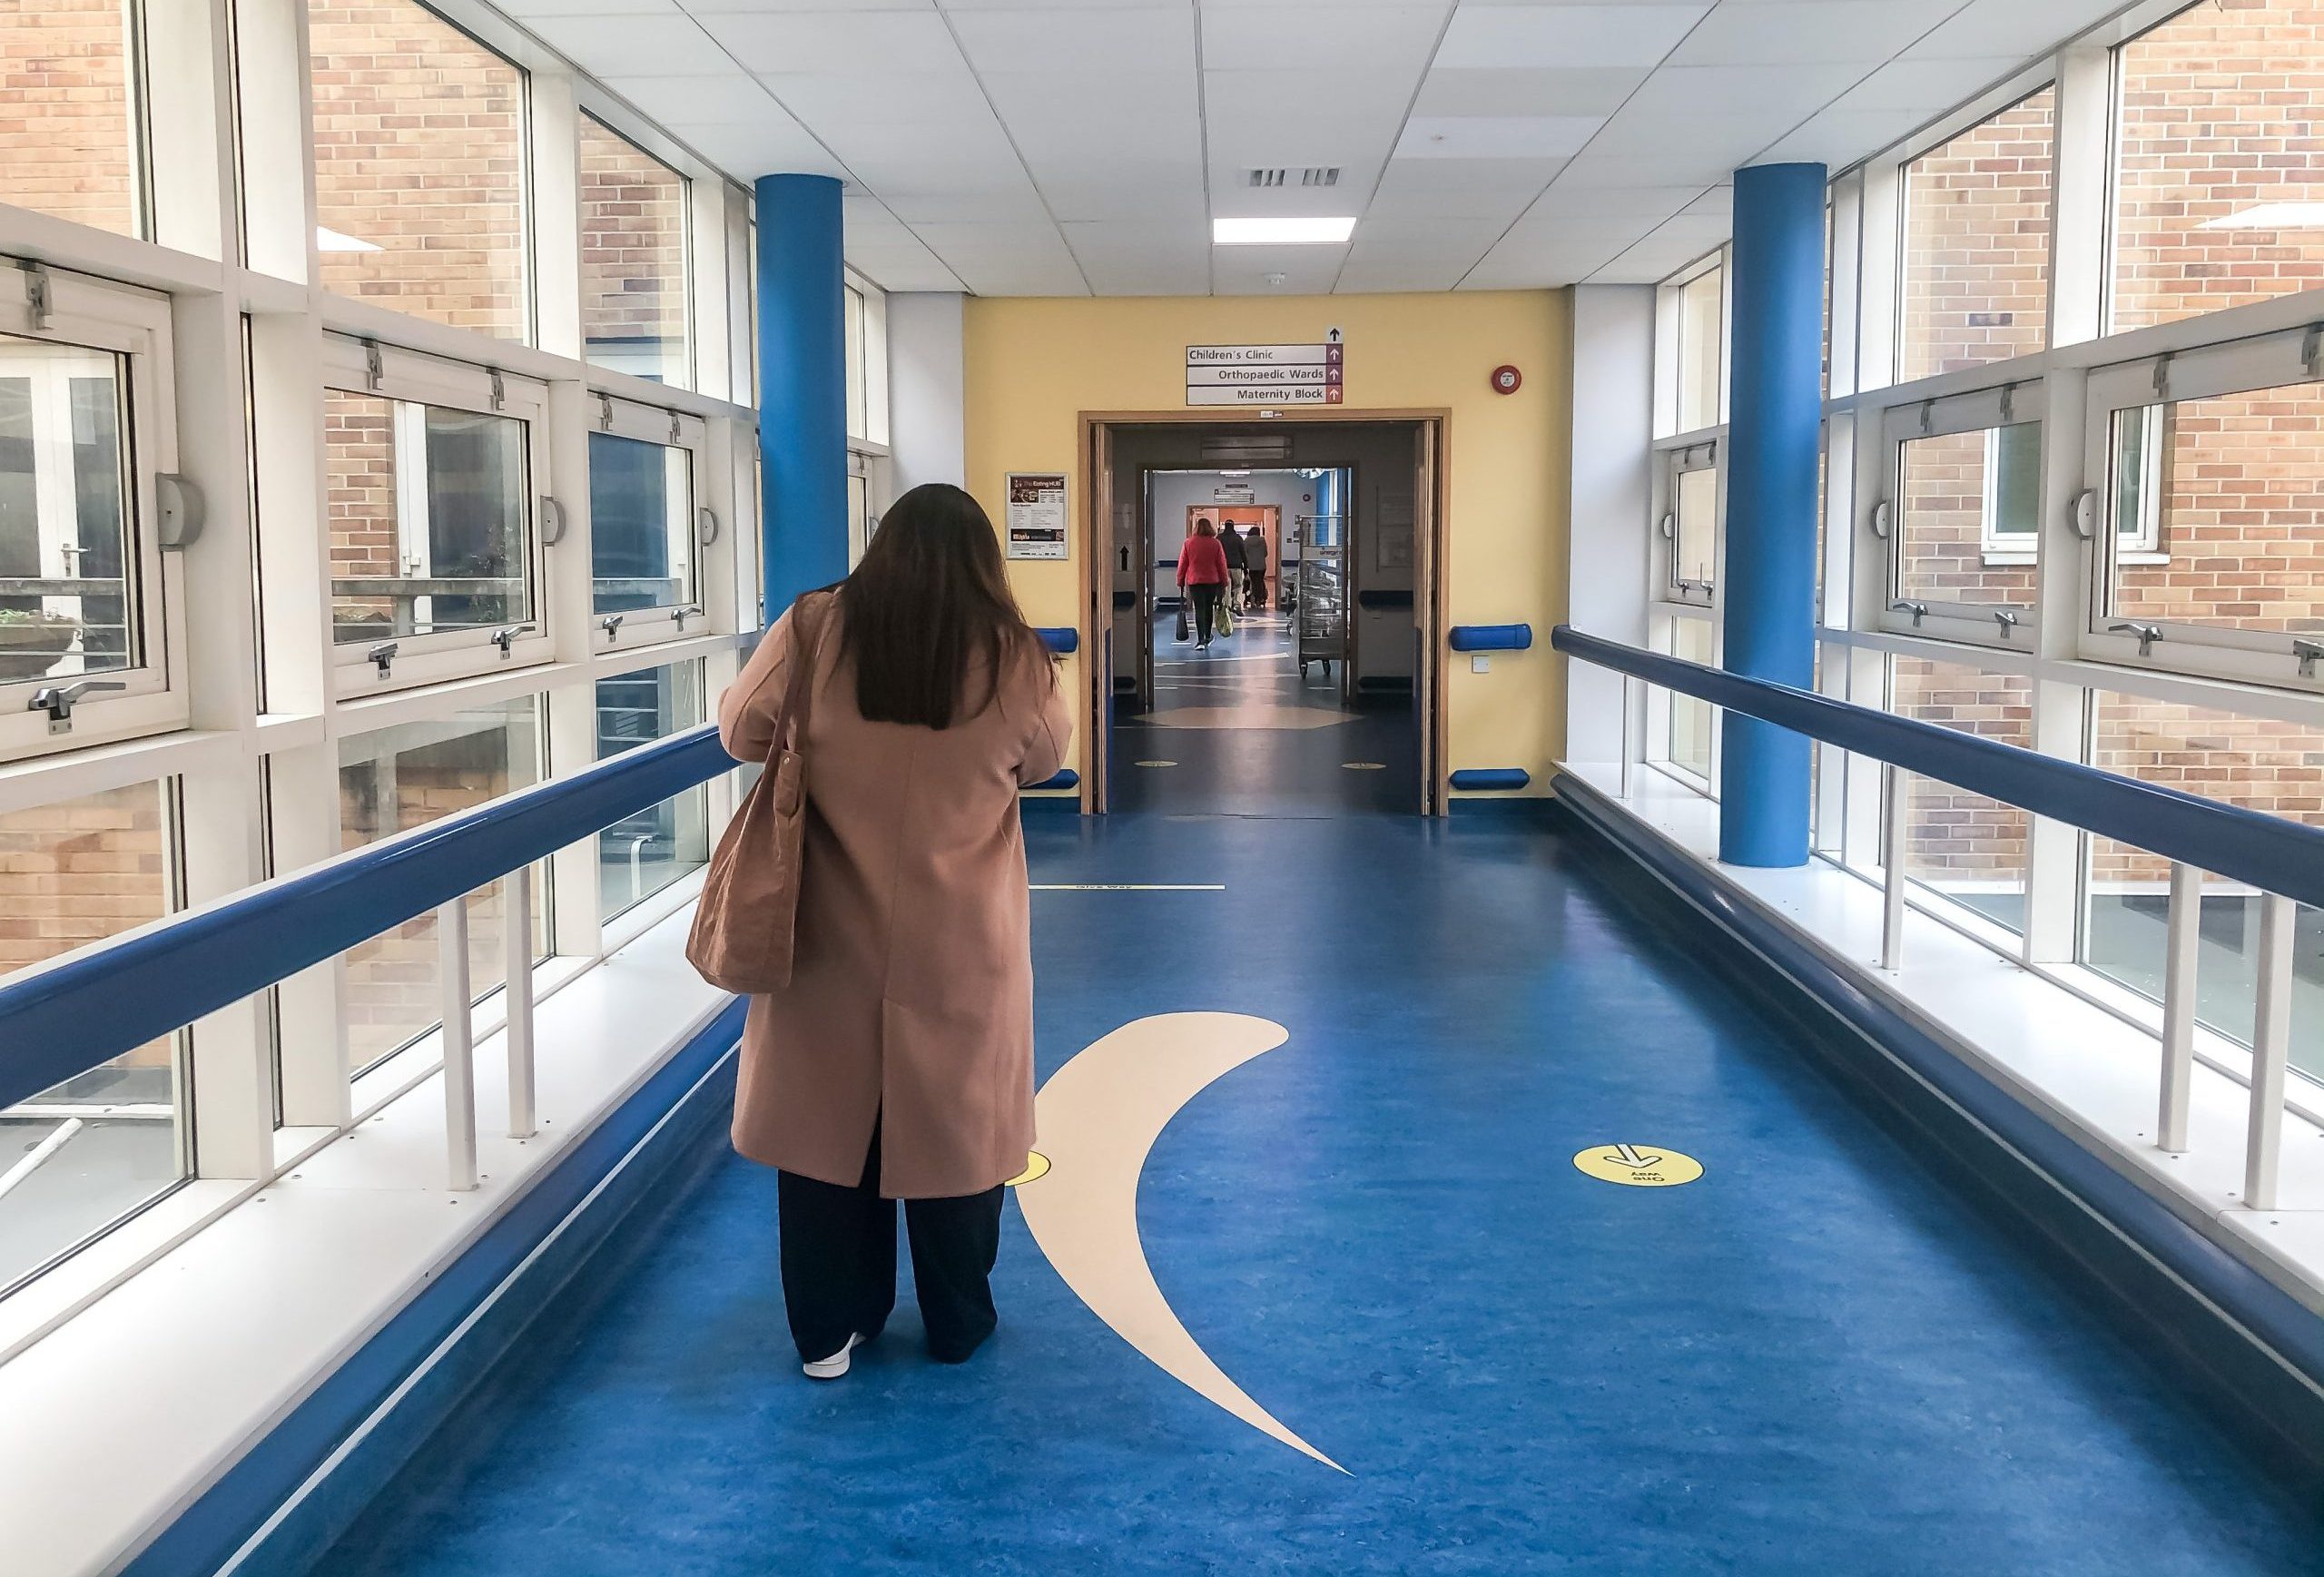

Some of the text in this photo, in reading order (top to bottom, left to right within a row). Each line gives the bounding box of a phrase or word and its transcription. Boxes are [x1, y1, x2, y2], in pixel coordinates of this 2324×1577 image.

[1189, 350, 1273, 360] Children's Clinic
[1218, 370, 1324, 381] Orthopaedic Wards
[1237, 389, 1323, 400] Maternity Block
